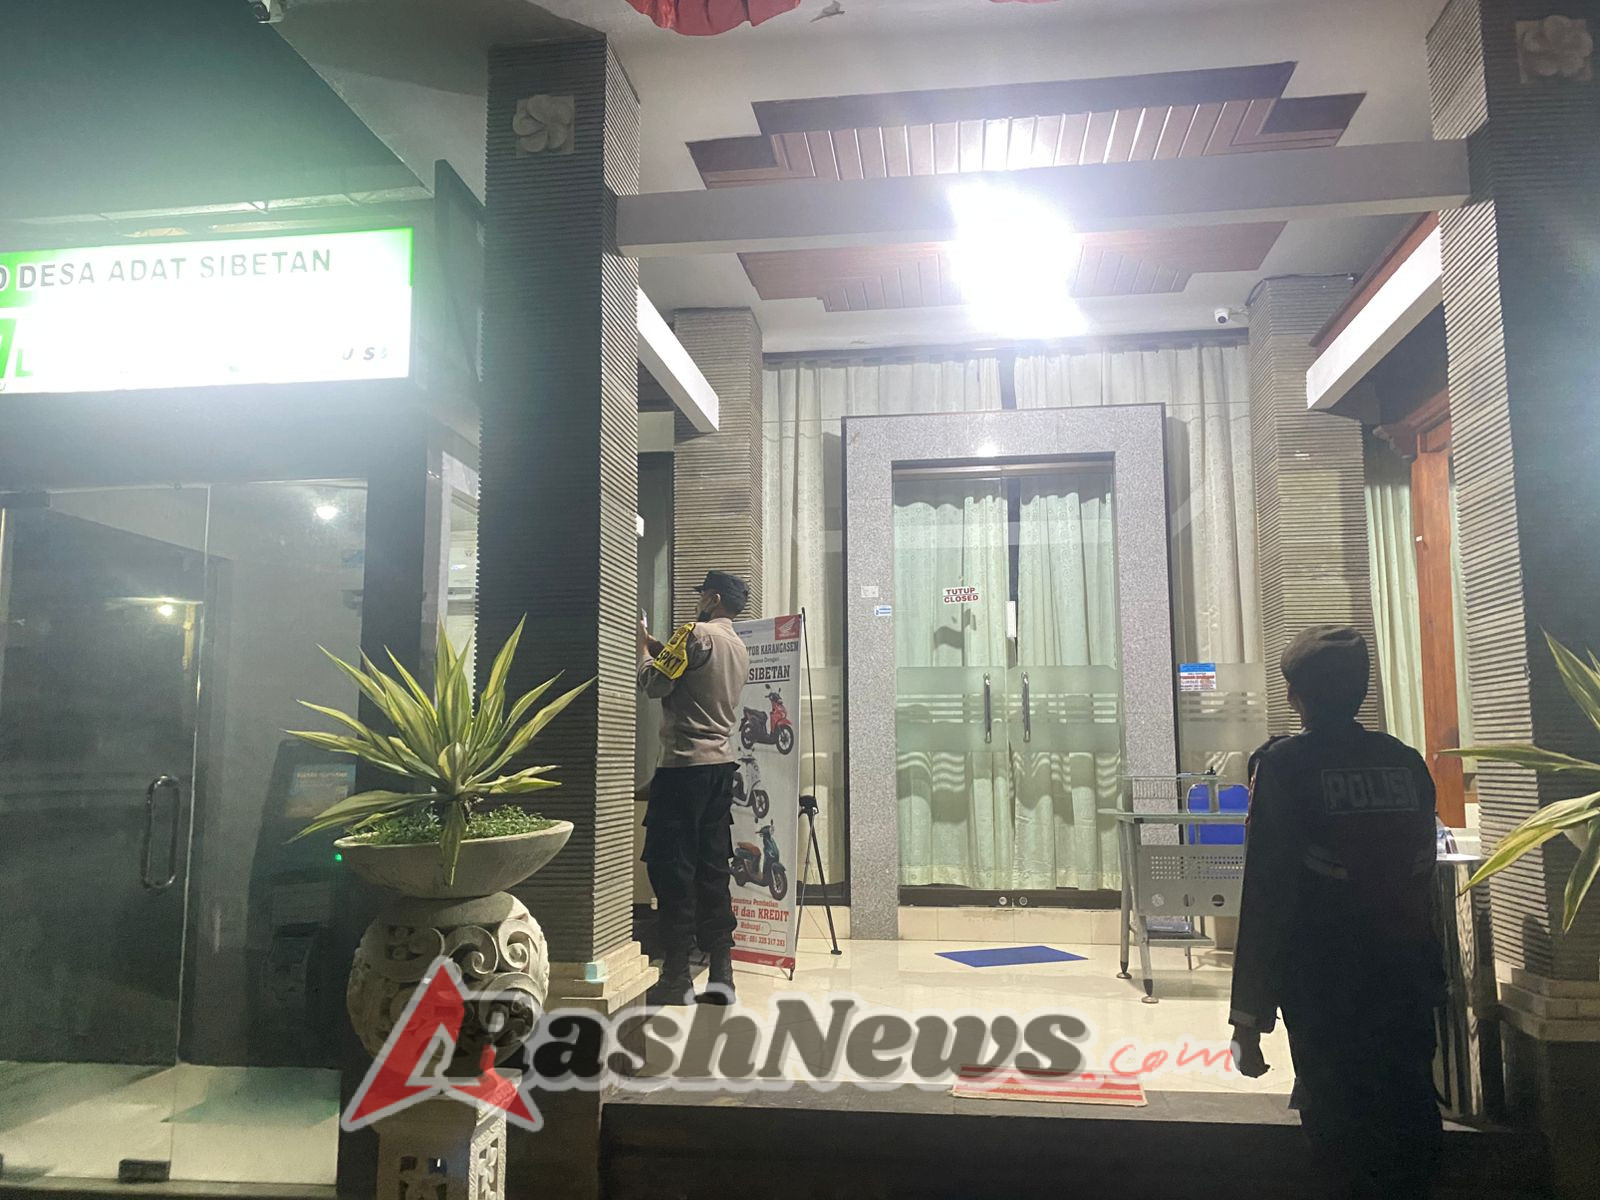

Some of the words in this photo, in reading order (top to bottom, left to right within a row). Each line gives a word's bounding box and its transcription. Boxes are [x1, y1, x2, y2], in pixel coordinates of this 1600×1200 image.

[19, 262, 95, 288] DESA
[108, 257, 187, 282] ADAT
[200, 249, 331, 279] SIBETAN
[943, 594, 979, 603] CLOSED
[945, 587, 976, 595] TUTUP
[746, 645, 760, 656] TOR
[656, 649, 682, 670] SPKT
[748, 665, 791, 681] SIBETAN
[740, 907, 756, 918] dan
[758, 908, 789, 922] KREDIT
